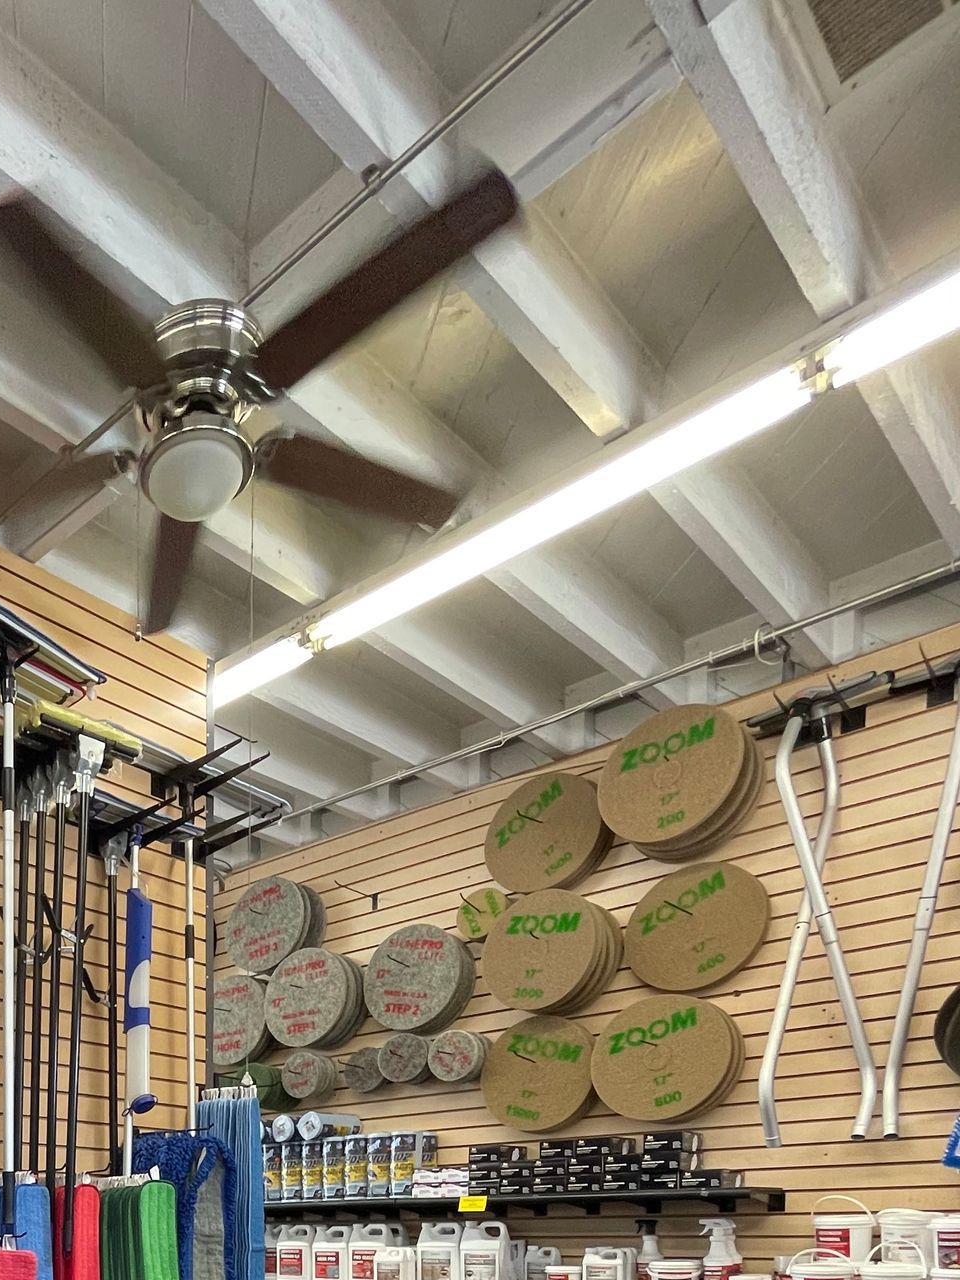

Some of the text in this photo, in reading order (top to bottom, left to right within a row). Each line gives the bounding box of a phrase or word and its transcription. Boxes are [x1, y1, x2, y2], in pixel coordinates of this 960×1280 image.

[620, 715, 717, 774] ZOOM
[495, 779, 563, 848] ZOOM
[657, 810, 686, 830] 200
[640, 869, 725, 935] ZOOM
[506, 912, 582, 935] ZOOM
[248, 944, 271, 960] STEP
[384, 1004, 421, 1017] STEP 2
[287, 1022, 308, 1035] STEP
[609, 1007, 697, 1056] ZOOM
[507, 1034, 584, 1063] ZOOM
